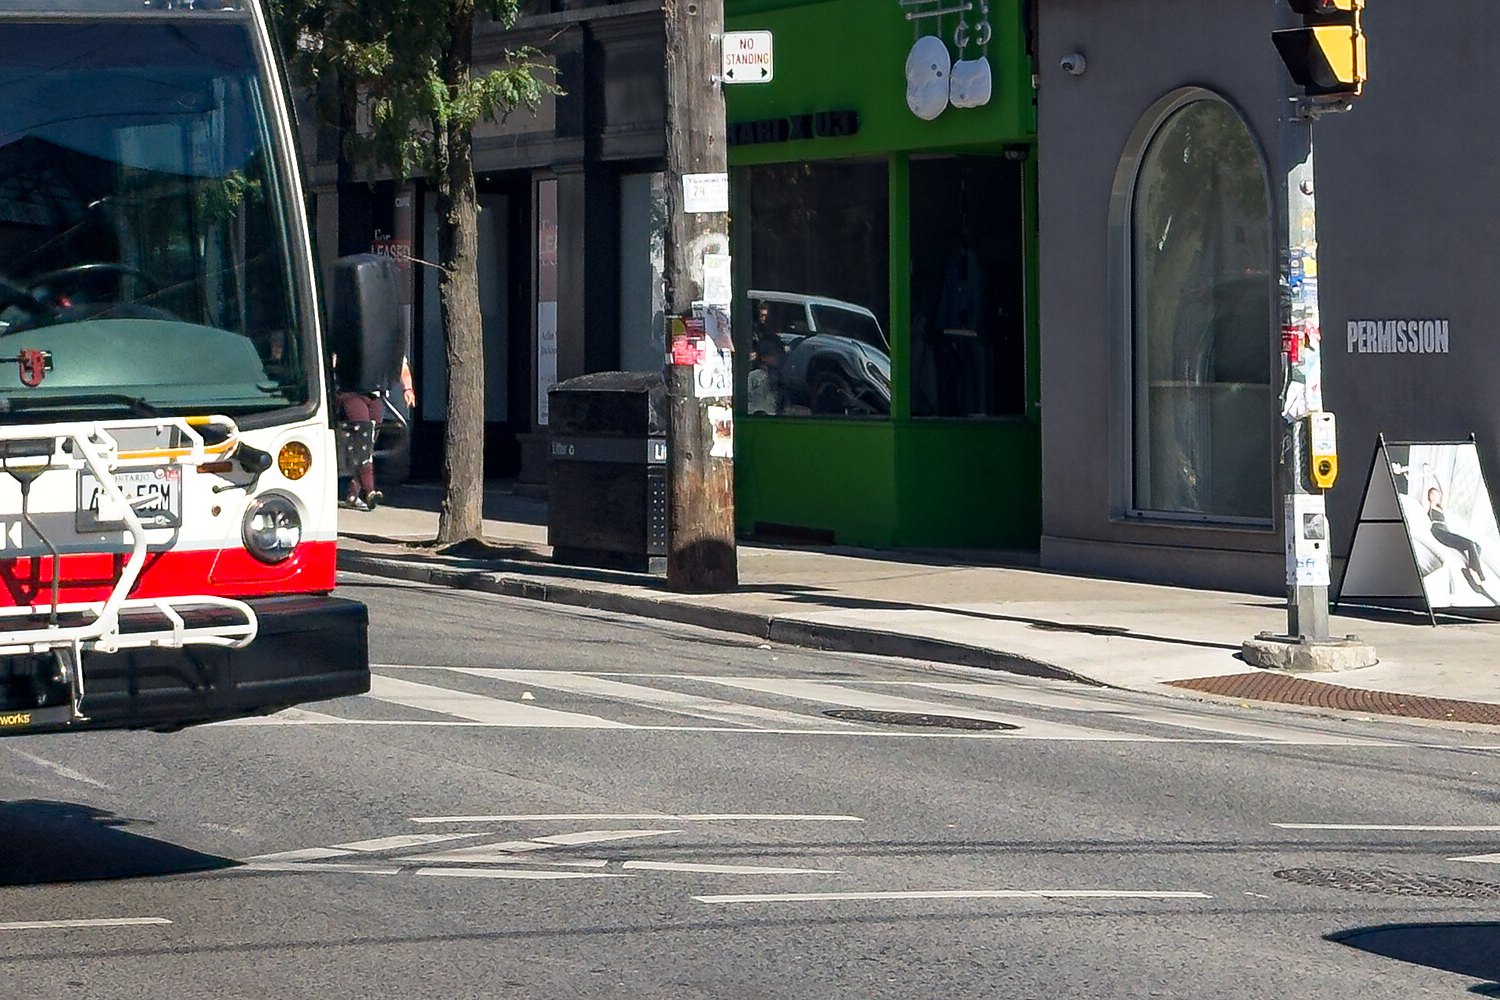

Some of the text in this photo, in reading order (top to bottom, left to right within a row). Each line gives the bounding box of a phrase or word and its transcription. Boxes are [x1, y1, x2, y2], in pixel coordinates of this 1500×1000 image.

[739, 37, 755, 50] NO
[725, 53, 770, 66] STANDING
[1347, 319, 1450, 354] PERMISSION
